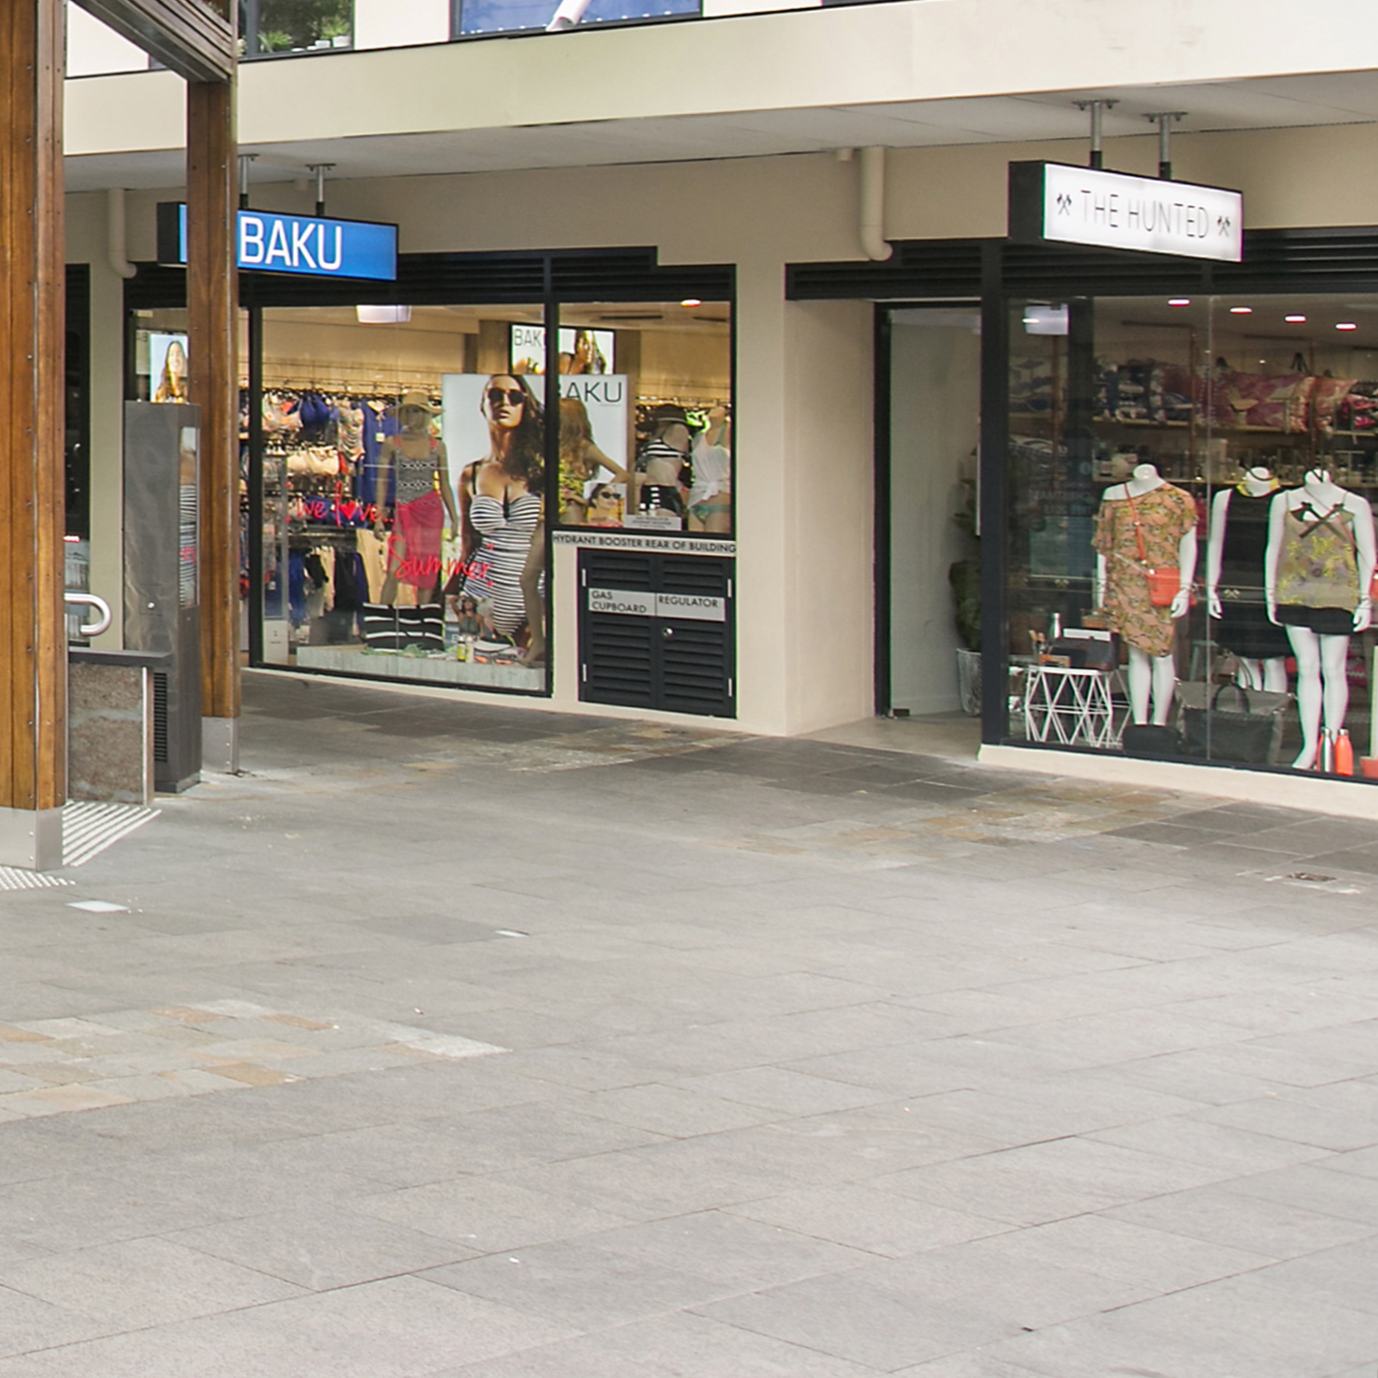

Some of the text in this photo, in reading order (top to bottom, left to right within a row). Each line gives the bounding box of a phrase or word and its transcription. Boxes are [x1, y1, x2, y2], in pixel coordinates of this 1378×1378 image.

[1081, 190, 1209, 239] THE HUNTED
[240, 216, 342, 271] BAKU
[514, 328, 543, 348] BAK
[558, 381, 622, 403] AKU
[296, 497, 328, 518] we
[553, 533, 736, 554] HYDRANT BOOSTER REAR OF BUILDING
[388, 534, 494, 580] Summer
[591, 590, 613, 601] GAS
[658, 595, 719, 608] REGULATOR
[591, 602, 647, 614] CUPBOARD
